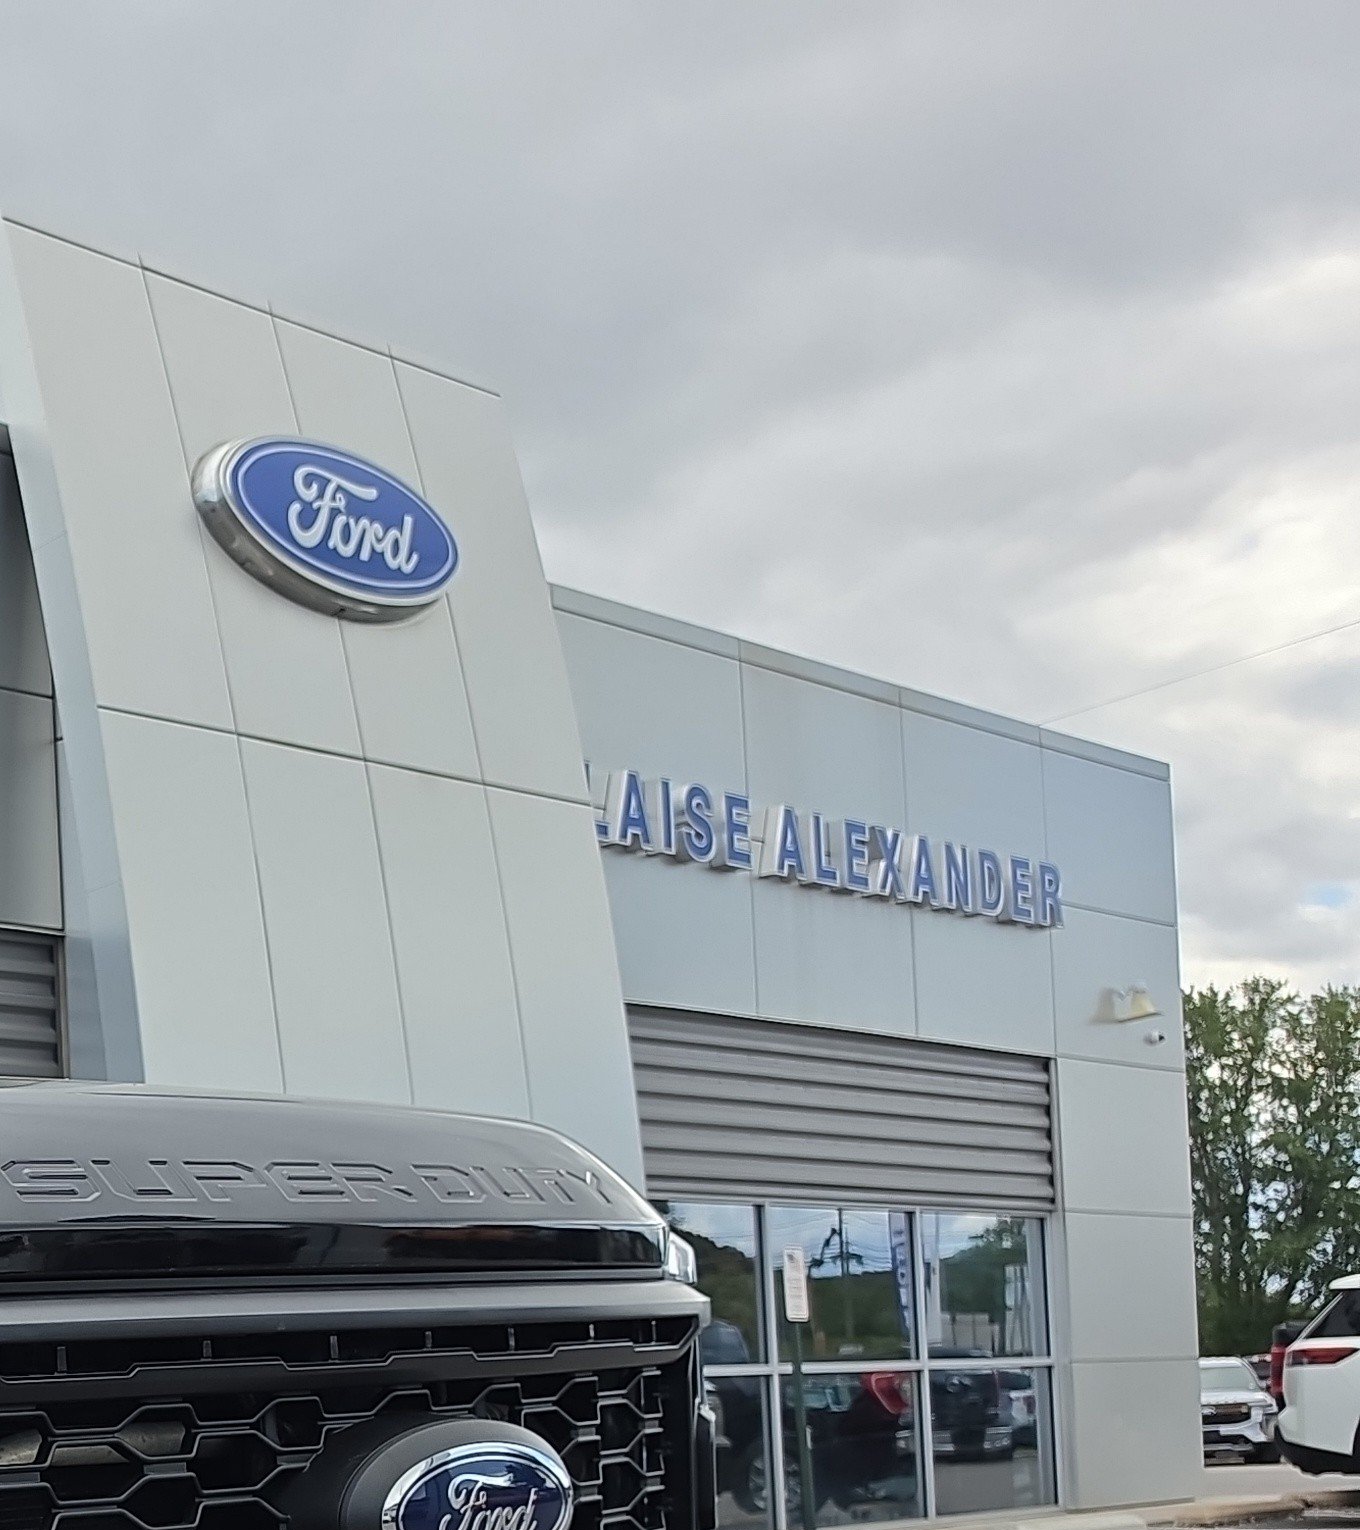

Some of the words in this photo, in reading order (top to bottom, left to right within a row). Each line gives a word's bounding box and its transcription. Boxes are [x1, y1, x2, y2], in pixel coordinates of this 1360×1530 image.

[287, 464, 419, 575] Ford
[775, 803, 1064, 928] ALEXANDER
[410, 1162, 613, 1208] DUTY
